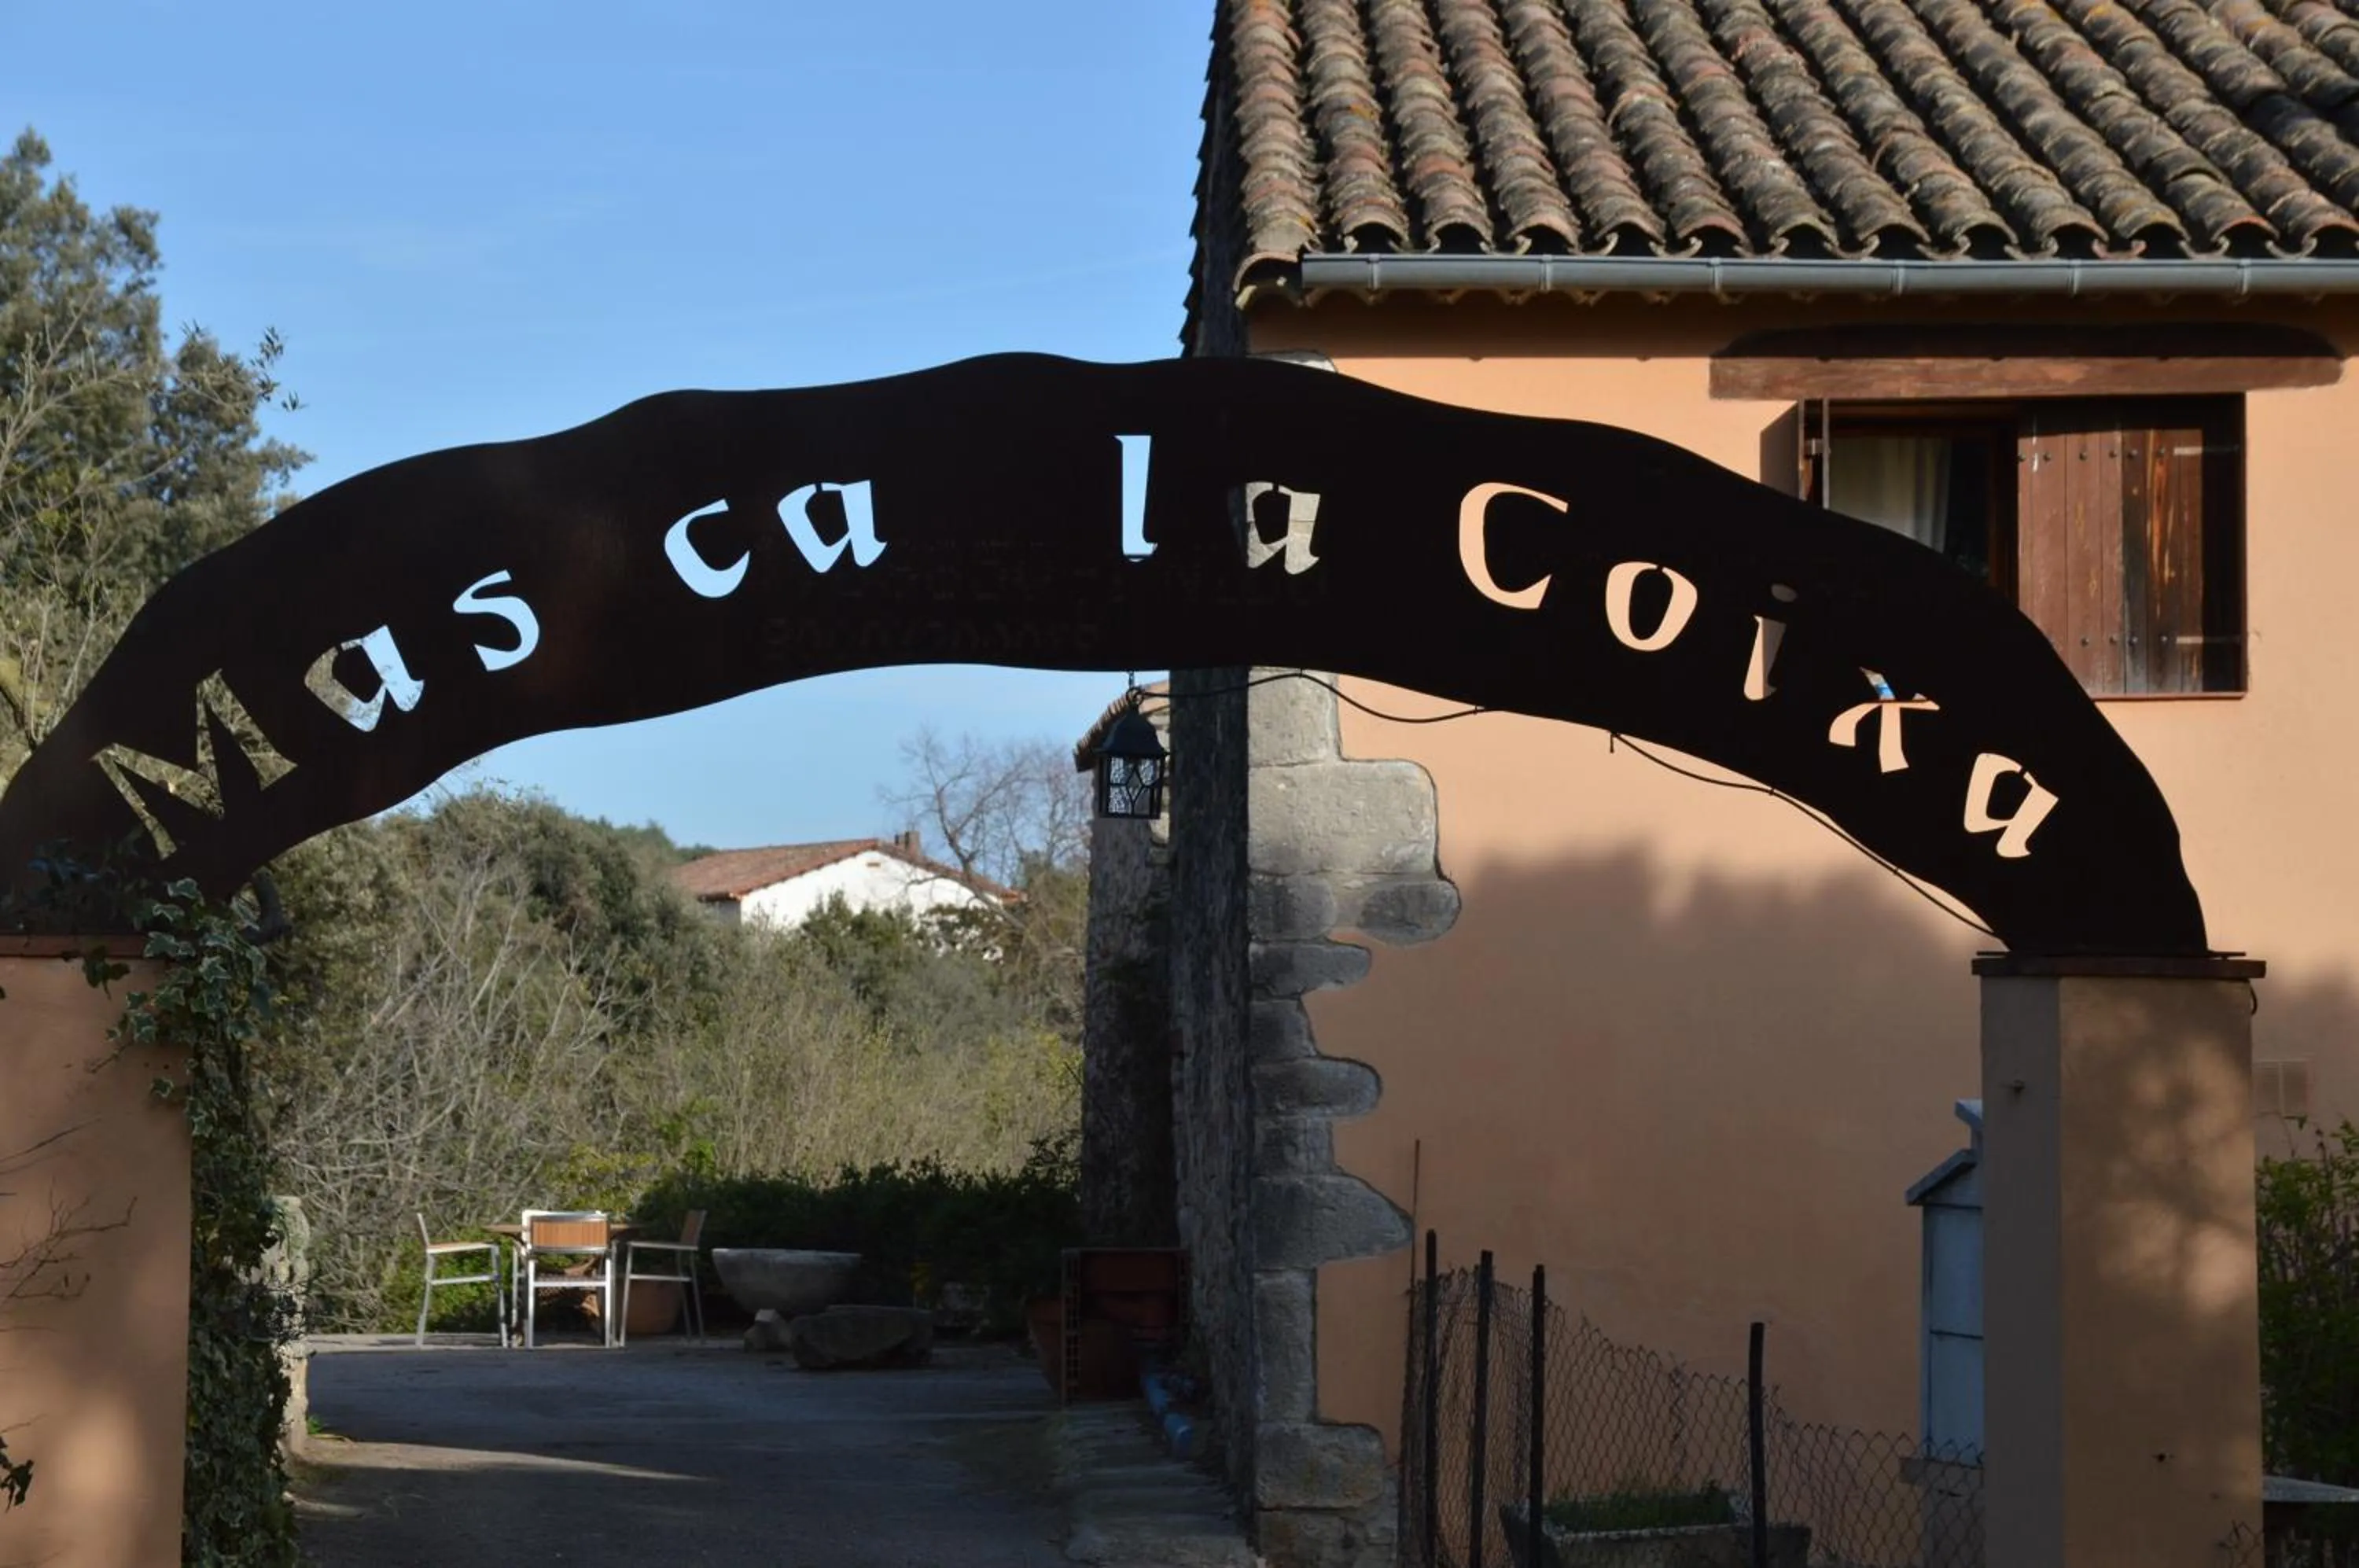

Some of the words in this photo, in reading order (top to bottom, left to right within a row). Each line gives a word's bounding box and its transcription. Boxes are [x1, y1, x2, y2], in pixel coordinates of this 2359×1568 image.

[90, 570, 540, 859] Mas
[663, 479, 888, 598] ca
[1113, 434, 1321, 575] la
